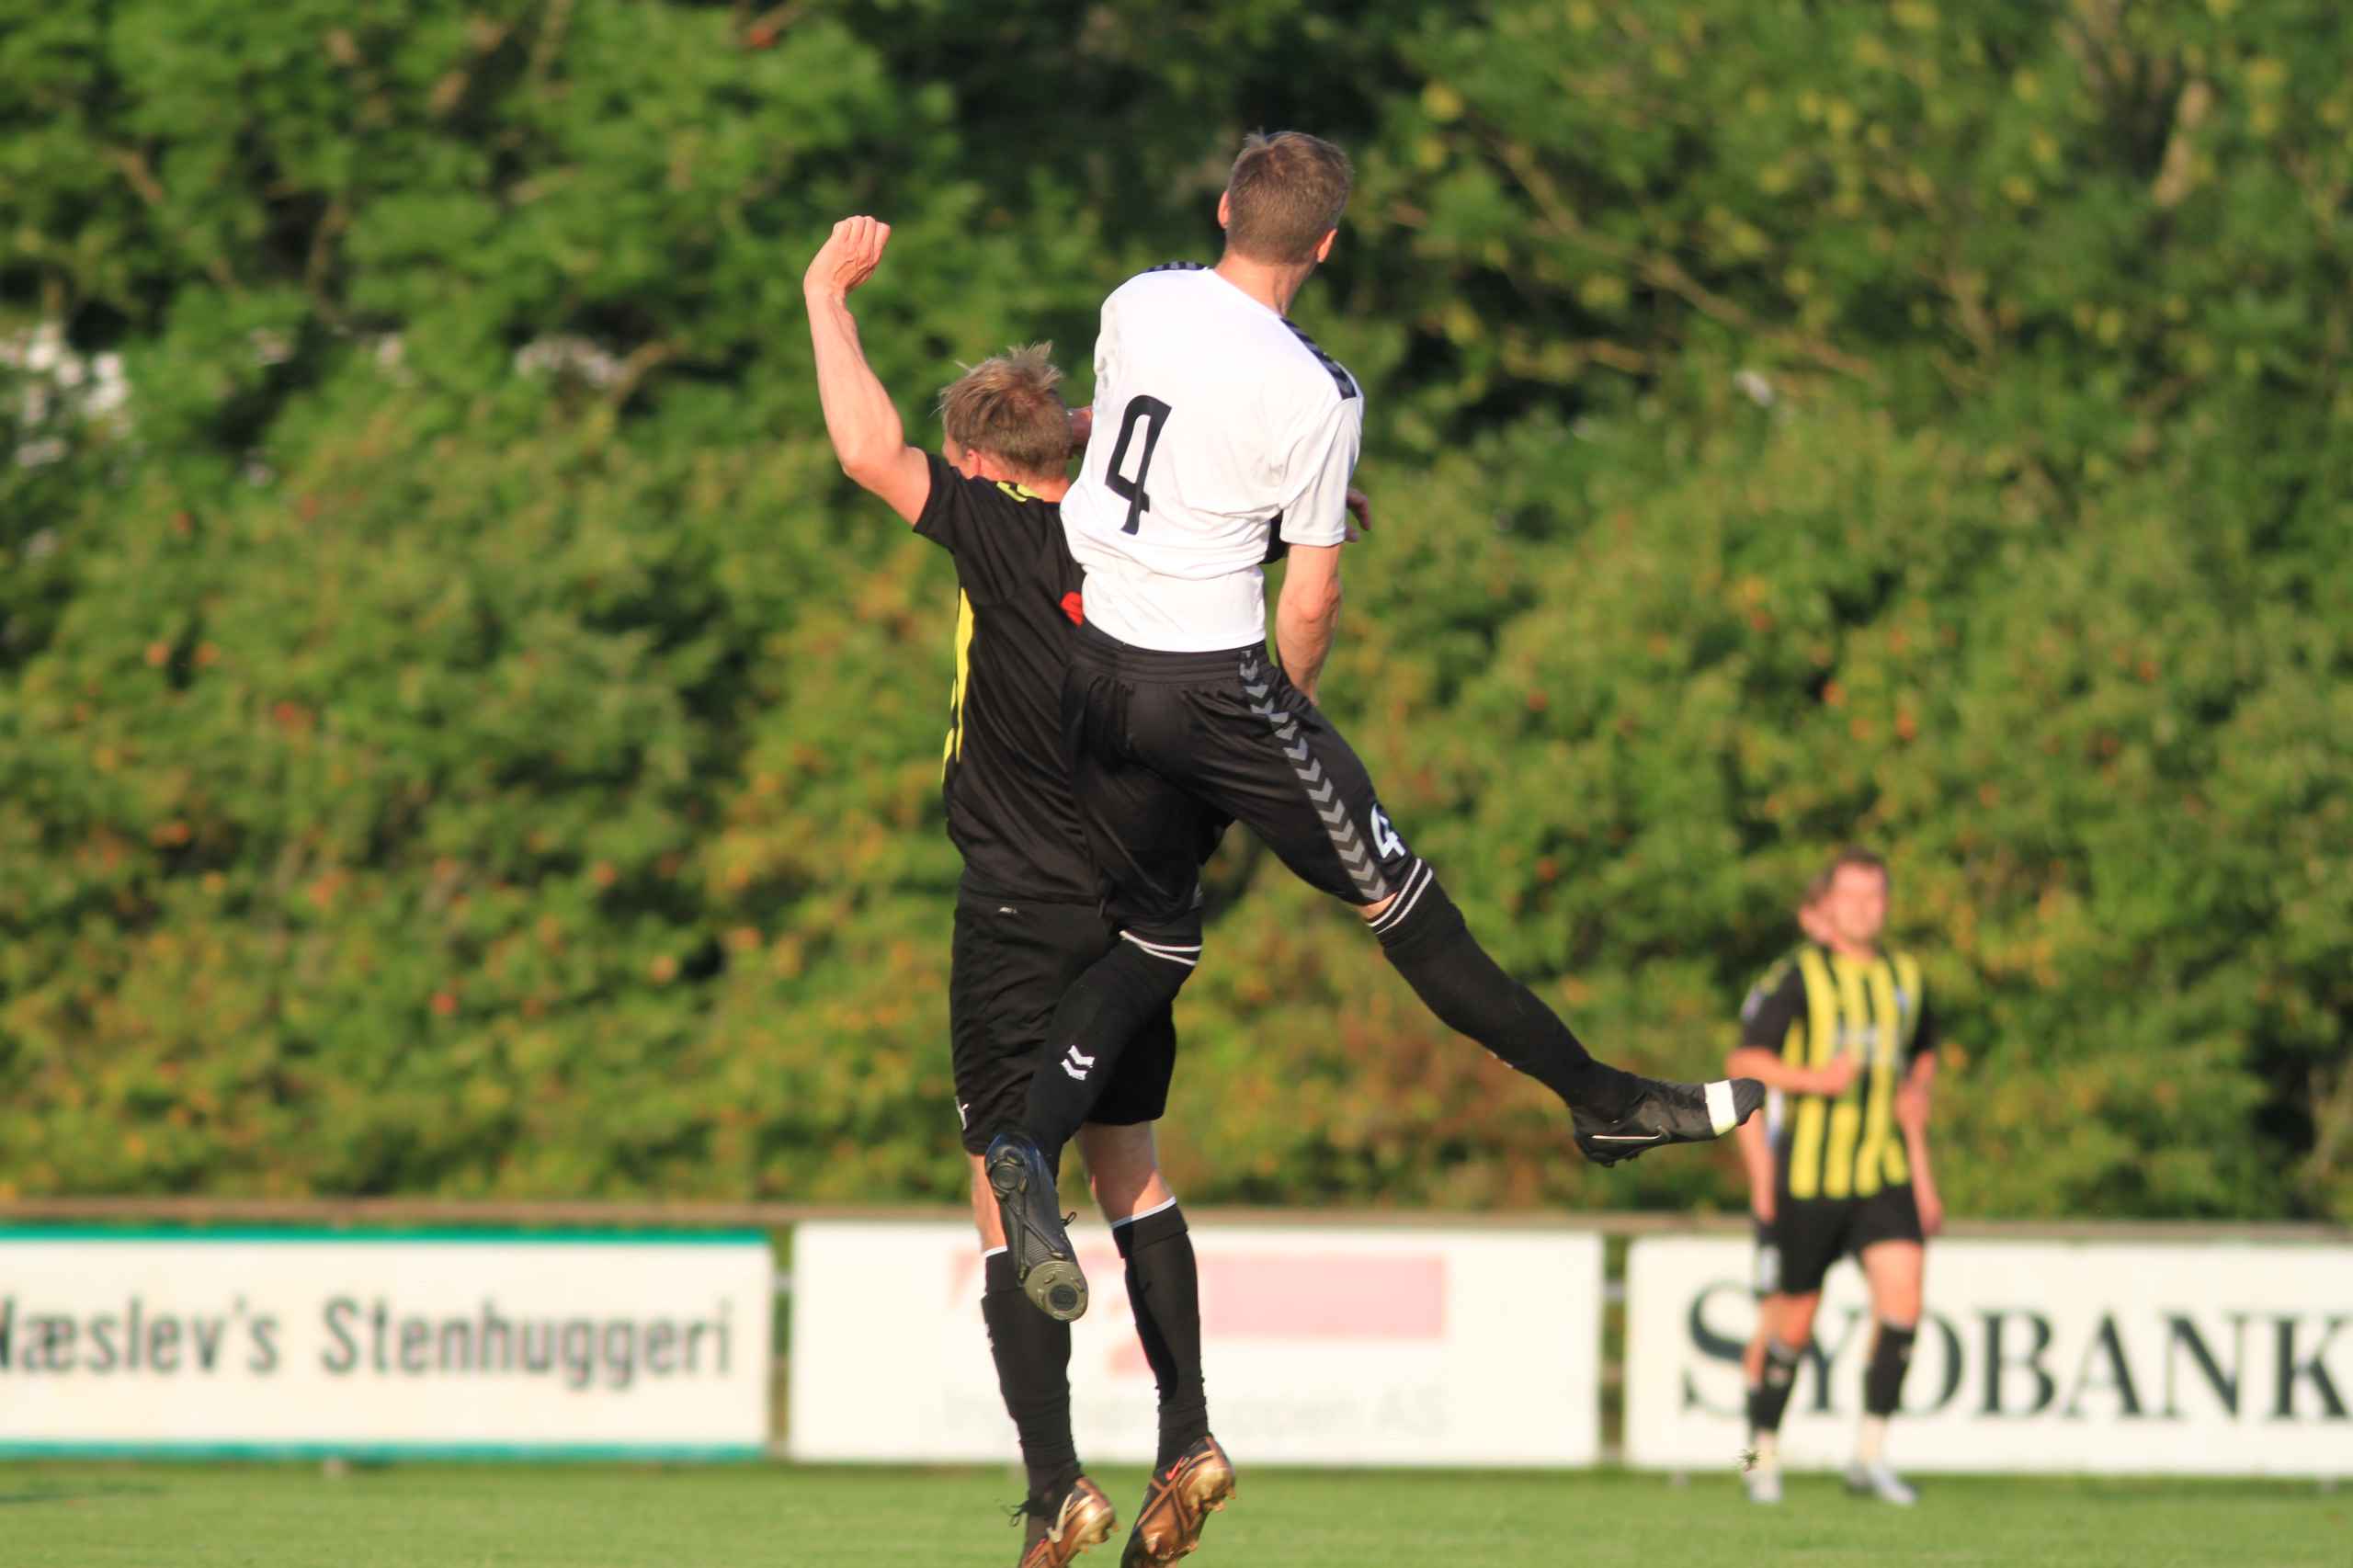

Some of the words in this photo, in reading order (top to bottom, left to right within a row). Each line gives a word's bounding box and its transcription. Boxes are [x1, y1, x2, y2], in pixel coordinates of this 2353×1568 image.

[1104, 394, 1172, 536] 4
[1370, 802, 1406, 858] 4
[322, 1297, 733, 1391] Stenhuggeri
